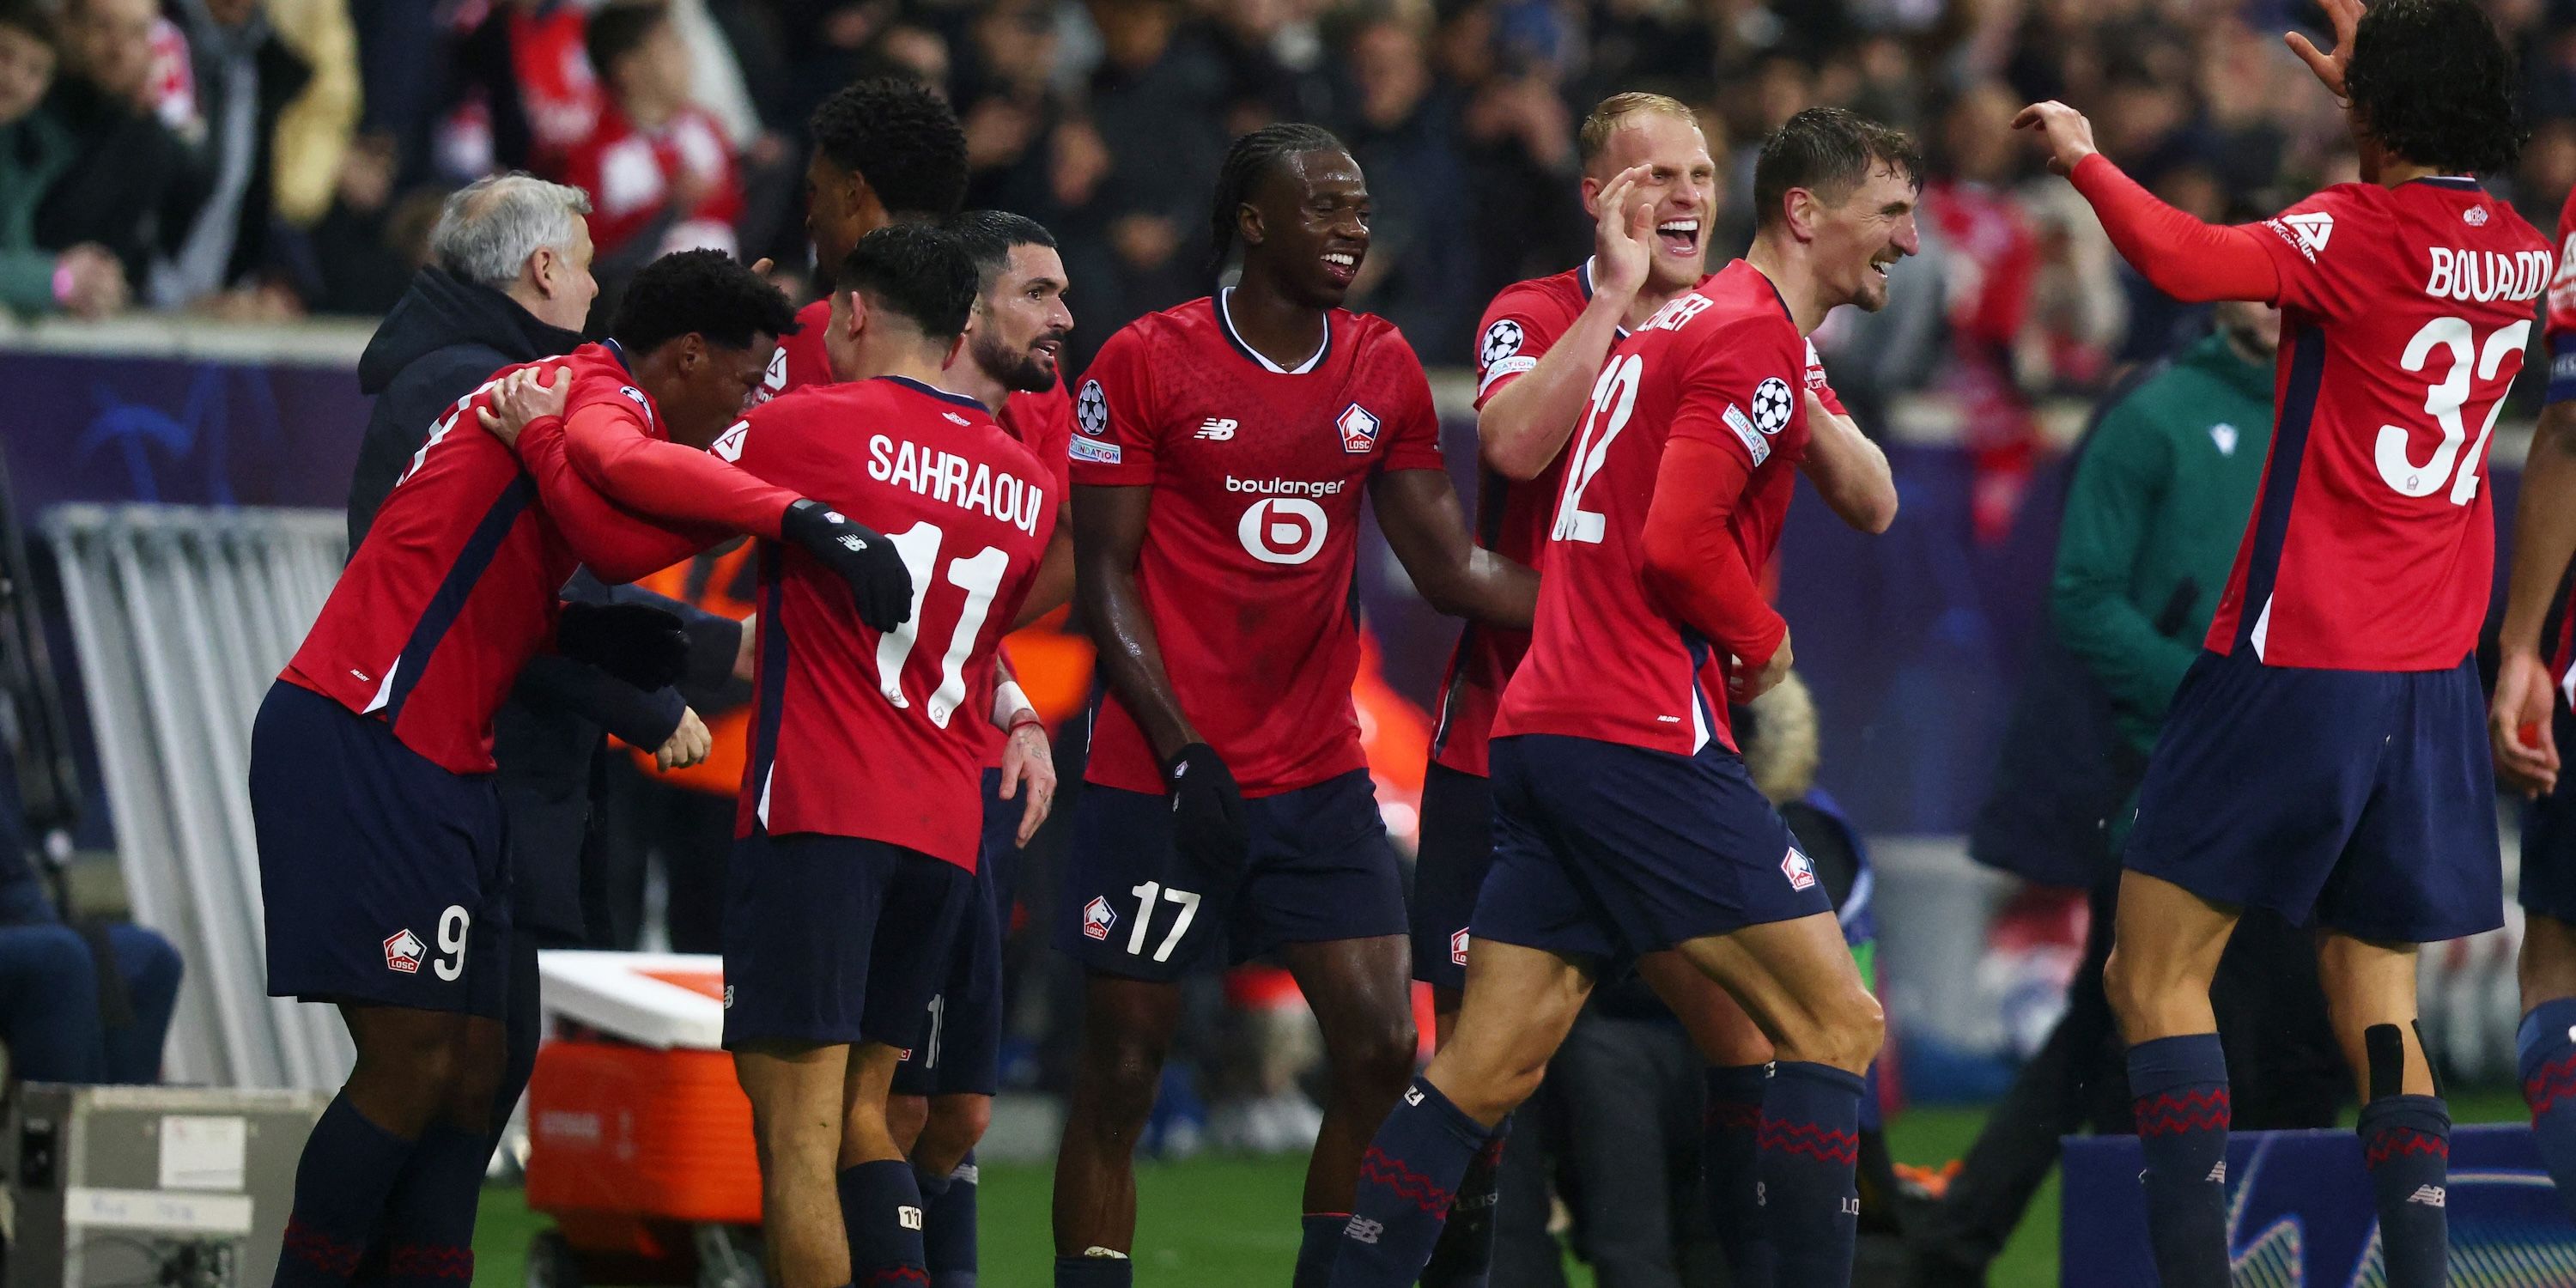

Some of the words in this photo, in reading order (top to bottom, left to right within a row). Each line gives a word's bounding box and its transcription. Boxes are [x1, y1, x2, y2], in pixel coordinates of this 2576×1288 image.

[1728, 408, 1766, 460] FOUNDATION
[2374, 316, 2532, 507] 32
[1348, 440, 1370, 450] LOSC
[1552, 353, 1643, 544] 12
[867, 434, 1042, 538] SAHRAOUI
[1226, 475, 1345, 497] boulanger
[876, 520, 1010, 730] 11
[434, 904, 471, 981] 9
[1086, 926, 1104, 938] LOSC
[1127, 880, 1201, 963] 17
[391, 959, 415, 970] LOSC
[1455, 953, 1467, 963] LO
[926, 993, 945, 1069] 1
[1841, 1197, 1860, 1216] LO
